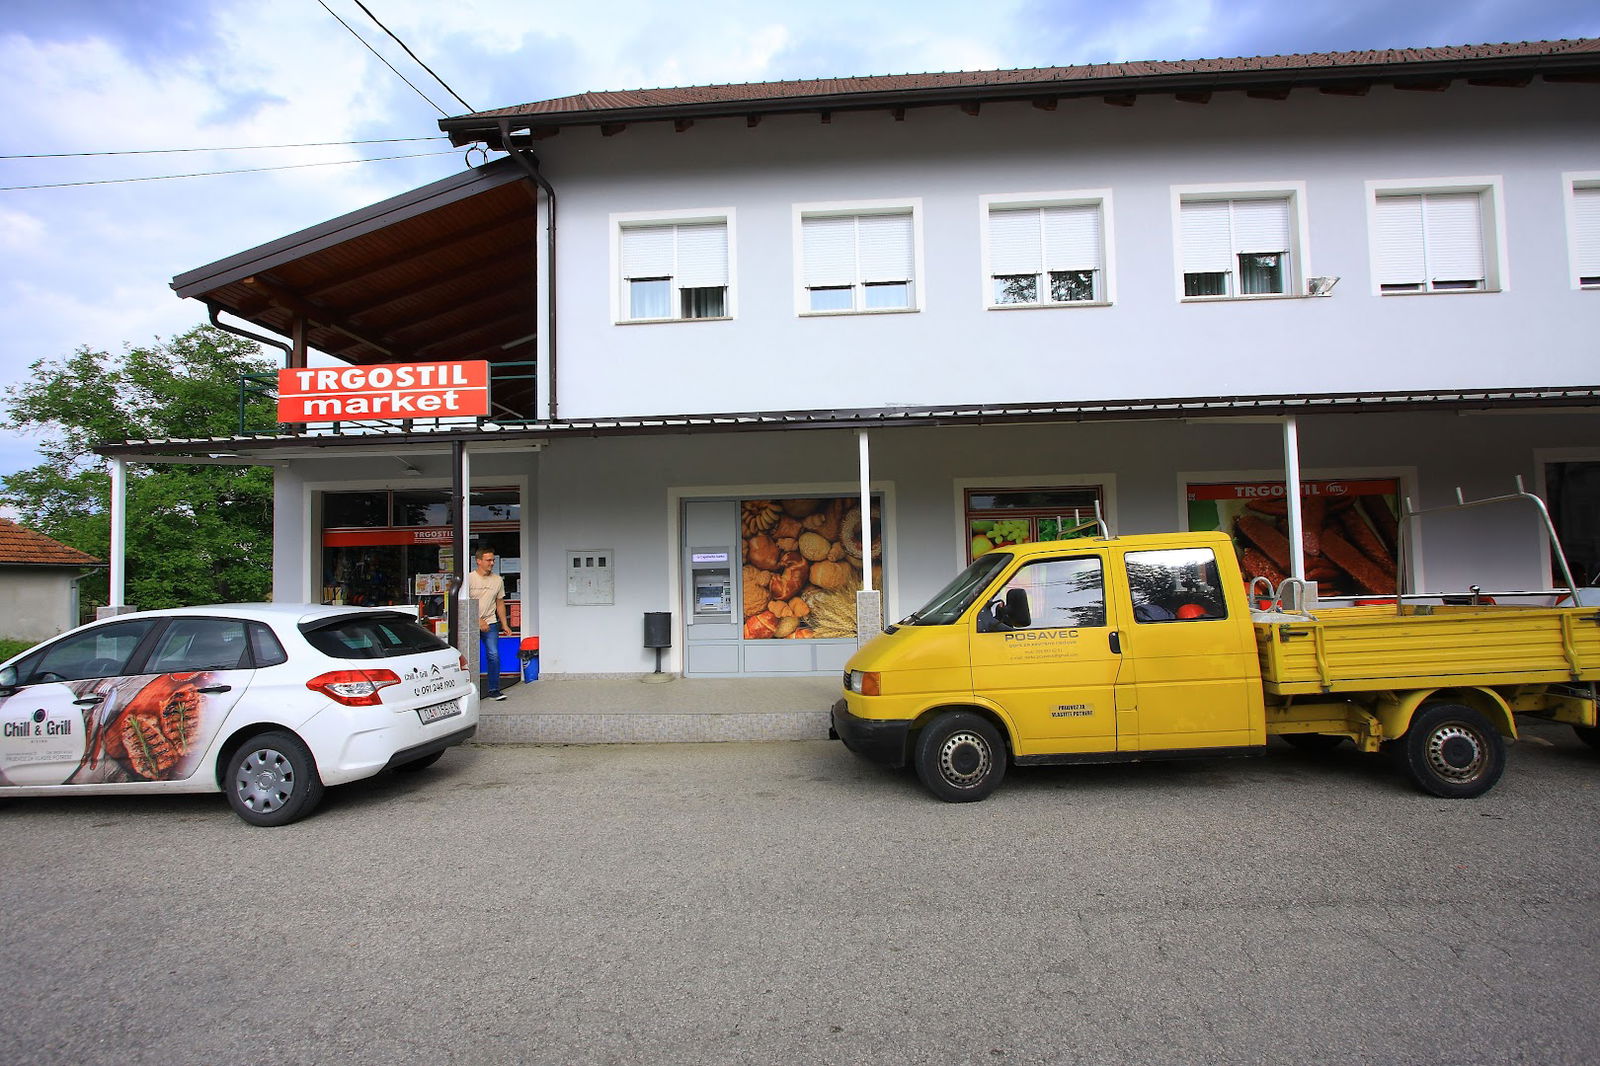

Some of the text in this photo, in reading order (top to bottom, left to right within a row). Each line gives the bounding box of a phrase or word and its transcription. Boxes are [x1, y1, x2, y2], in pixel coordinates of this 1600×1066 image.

[296, 365, 468, 391] TRGOSTIL
[303, 391, 460, 415] market
[1234, 484, 1320, 497] TRGOIL
[1005, 630, 1079, 641] POSAVEC
[4, 720, 71, 737] Chill & Grill
